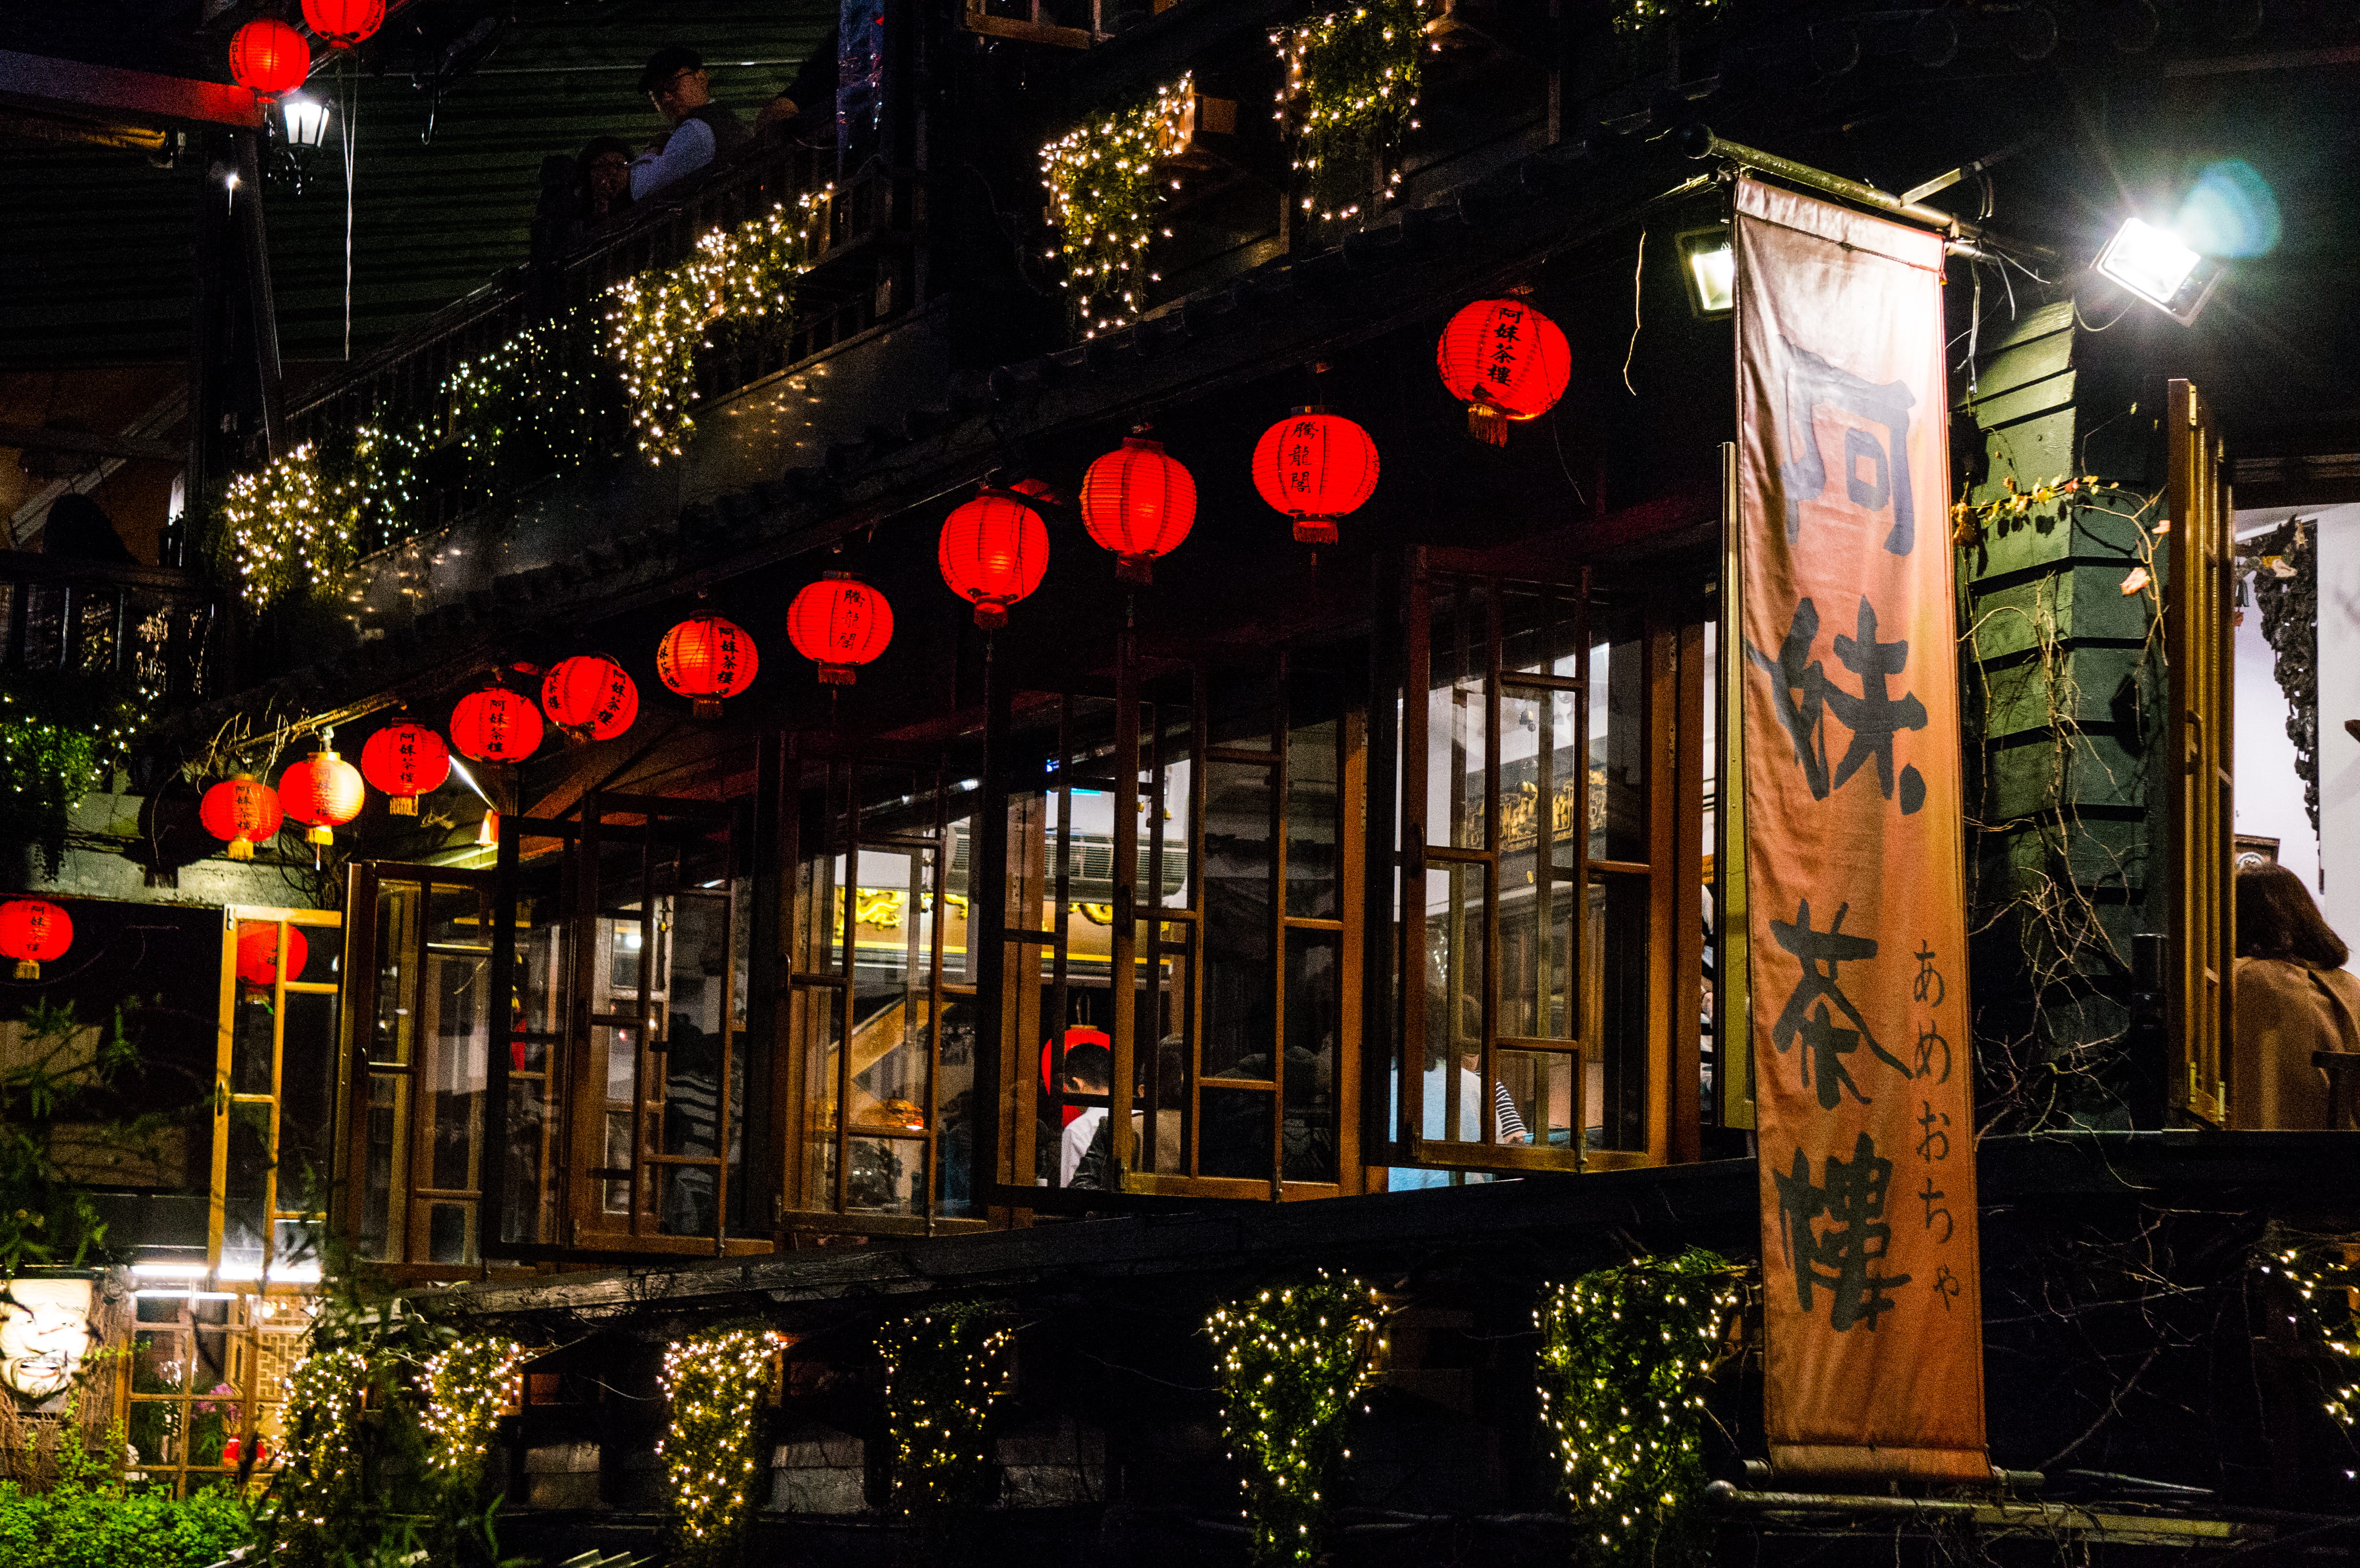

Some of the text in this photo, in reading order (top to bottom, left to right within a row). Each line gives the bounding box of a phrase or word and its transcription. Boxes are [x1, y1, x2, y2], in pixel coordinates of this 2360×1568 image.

[1487, 308, 1524, 387] 阿妹茶樓
[1288, 421, 1319, 493] 騰龍閣
[841, 589, 866, 650] 騰龍閣
[716, 626, 739, 685] 阿妹茶樓
[486, 699, 507, 753] 阿妹茶樓
[596, 669, 626, 726] 阿妹茶樓
[398, 732, 417, 782] 阿妹茶樓
[235, 785, 253, 830] 阿妹茶樓
[1745, 334, 1928, 1332] 阿妹茶樓
[1913, 939, 1959, 1311] あめおちゃ
